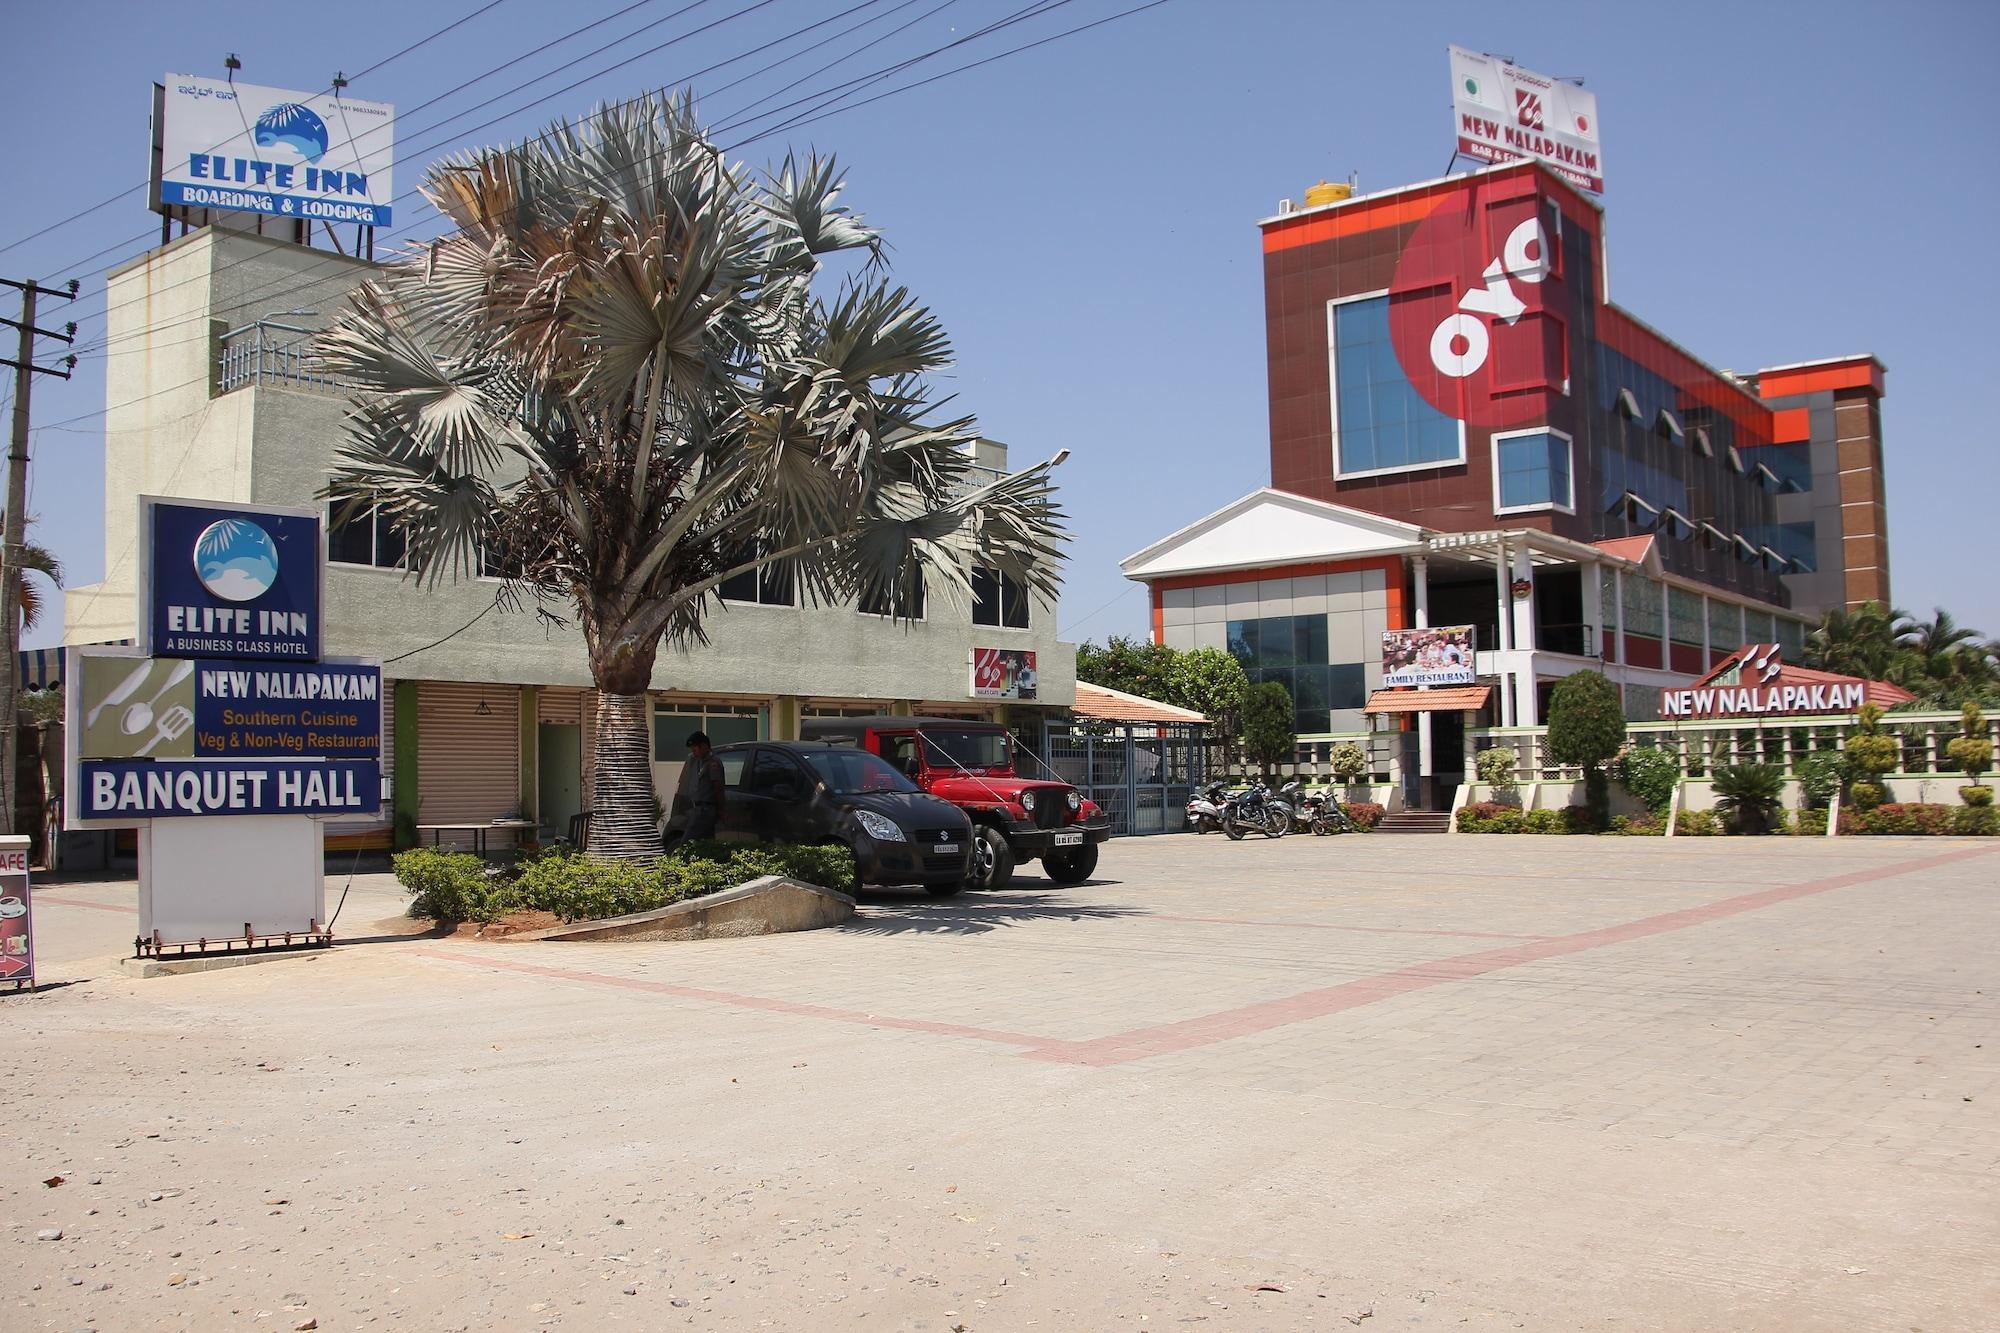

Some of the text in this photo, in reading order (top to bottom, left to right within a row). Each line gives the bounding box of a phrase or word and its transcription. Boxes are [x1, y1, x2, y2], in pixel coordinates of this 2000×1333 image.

[1462, 113, 1597, 171] NEW NALAPAKAM
[1471, 142, 1492, 158] BAR
[190, 153, 367, 197] ELITE INN
[183, 186, 374, 222] BOARDING & LODGING
[168, 605, 307, 637] ELITE INN
[167, 638, 308, 654] A BUSINESS CLASS HOTEL
[202, 670, 376, 701] NEW NALAPAKAM
[1386, 672, 1470, 684] FAMILY RESTAURANT
[1664, 683, 1864, 715] NEW NALAPAKAM
[223, 709, 358, 726] Southern Cuisine
[199, 732, 379, 750] Veg & Non-Veg Restaurant
[92, 770, 361, 814] BANQUET HALL
